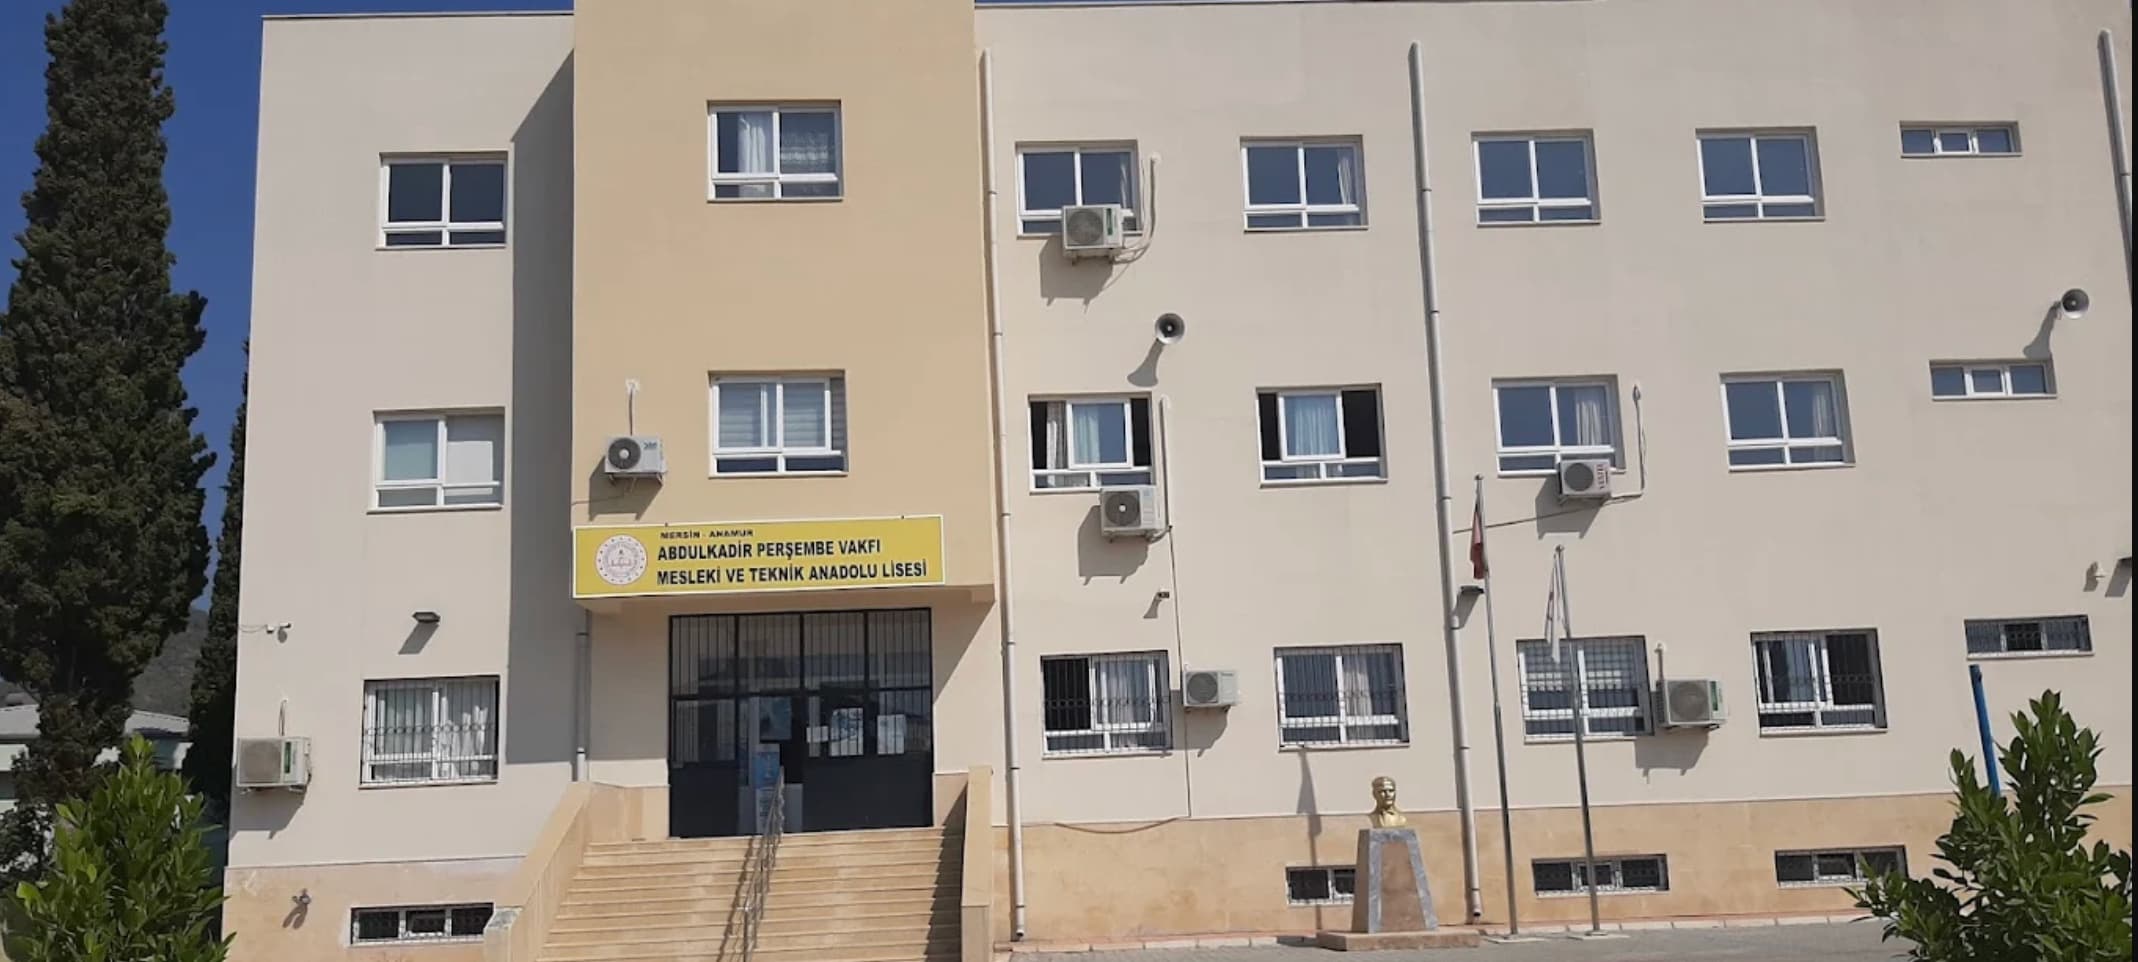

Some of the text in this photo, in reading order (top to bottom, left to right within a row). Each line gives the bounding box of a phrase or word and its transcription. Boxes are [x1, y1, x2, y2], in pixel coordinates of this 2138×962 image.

[661, 530, 700, 539] MERSİN
[709, 529, 753, 538] ANAMUR
[658, 540, 752, 560] ABDULKADİR
[757, 541, 834, 560] PERŞEMBE
[838, 539, 880, 555] VAKFI
[657, 559, 927, 585] MESLEKİ VE TEKNİK ANADOLU LİSESİ
